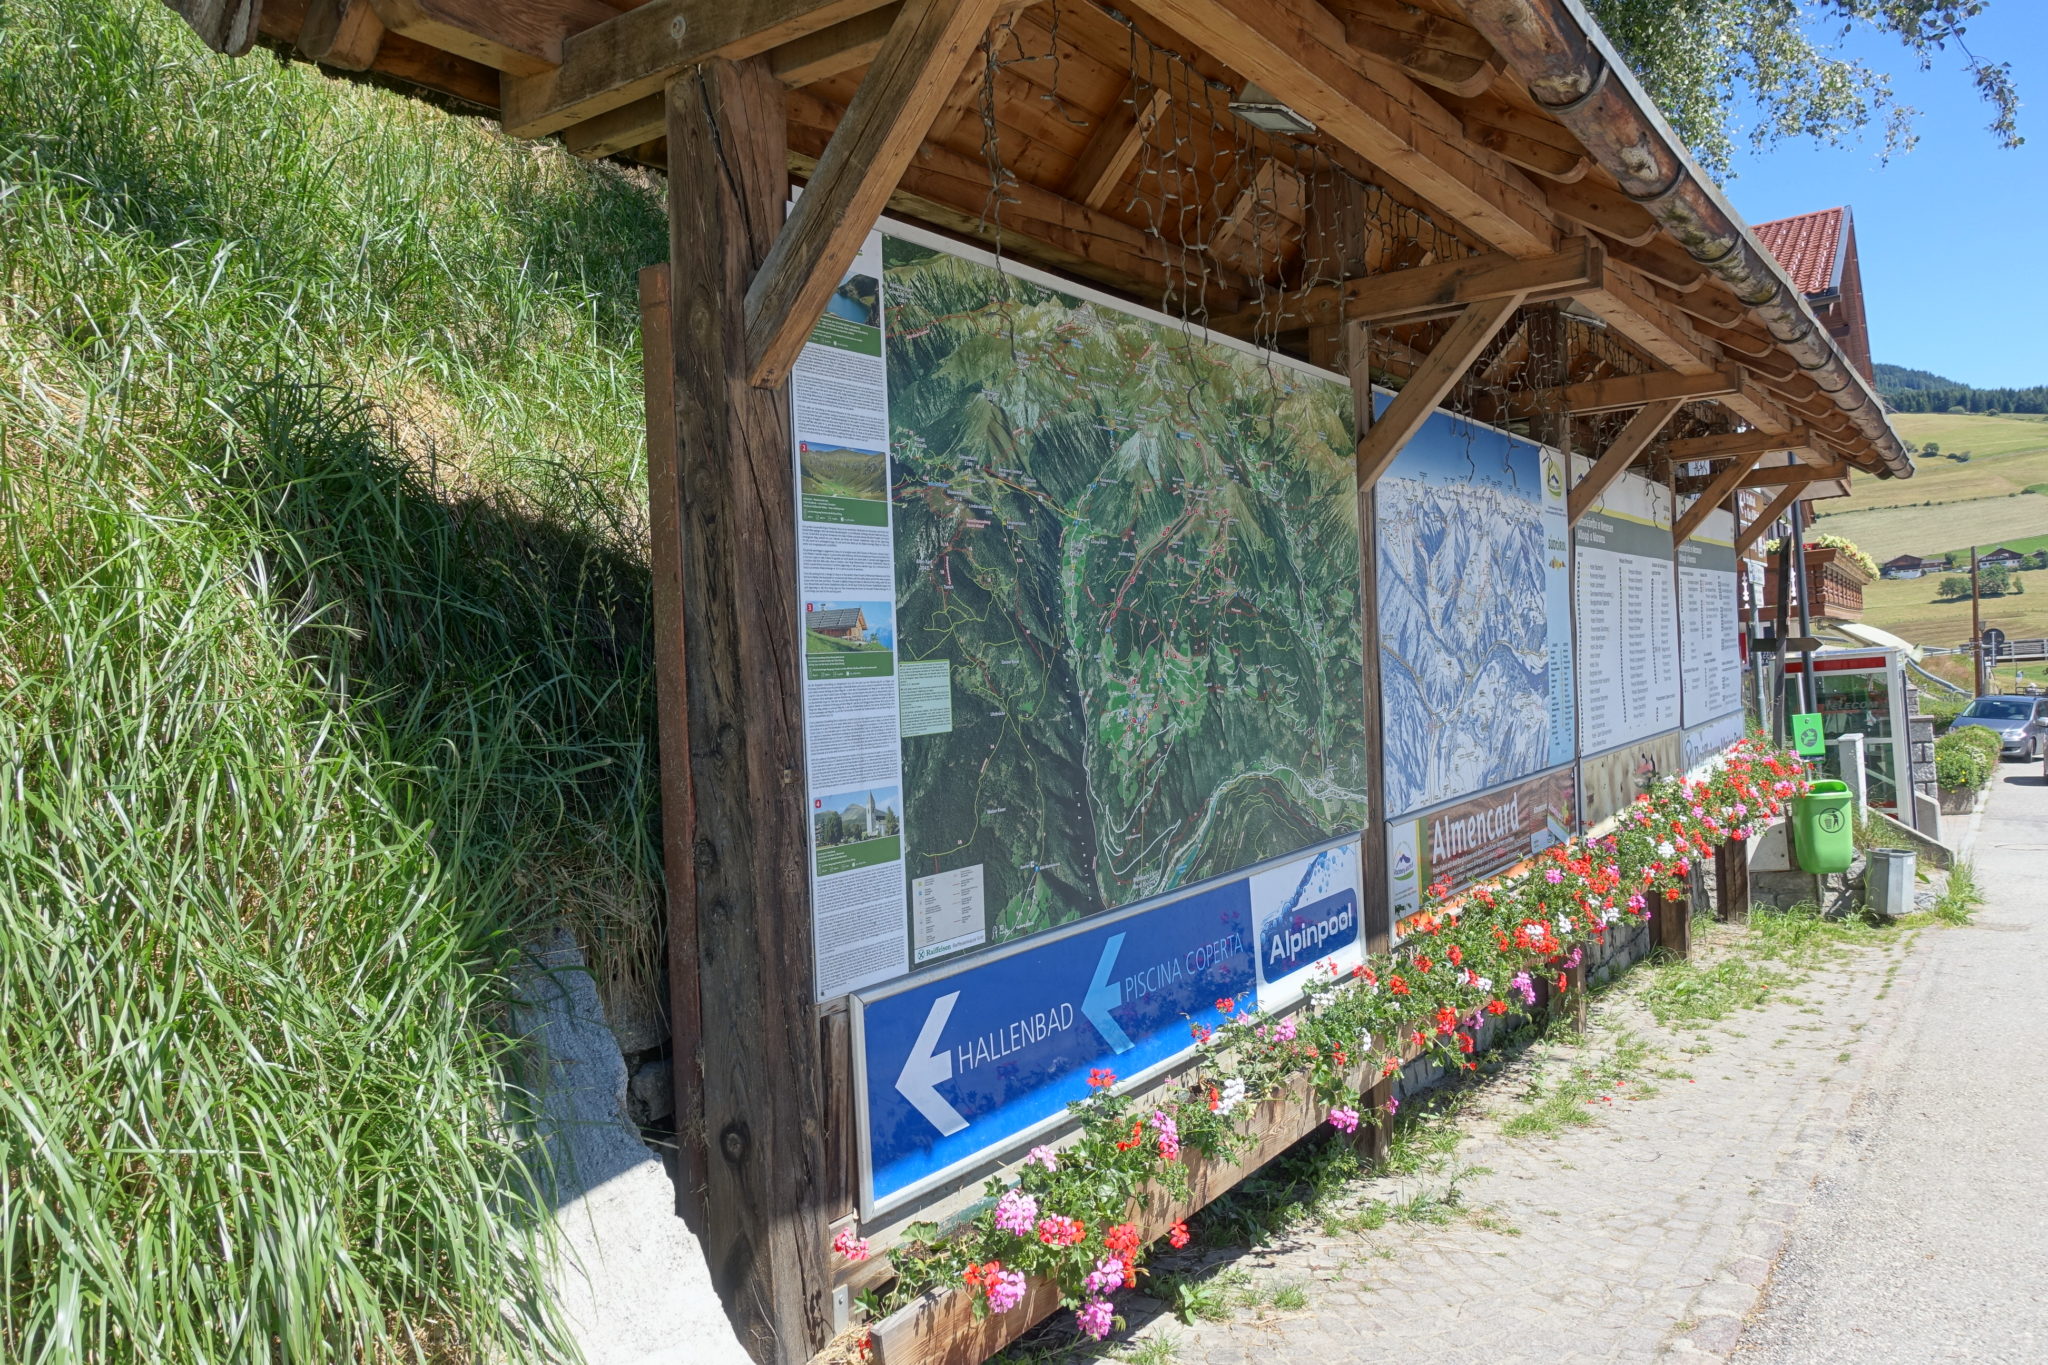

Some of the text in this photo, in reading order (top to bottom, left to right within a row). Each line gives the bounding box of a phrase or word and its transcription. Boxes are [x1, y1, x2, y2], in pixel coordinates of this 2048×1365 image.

[1432, 791, 1520, 864] Almencard
[1125, 932, 1244, 1002] PISCINA COPERTA
[1269, 902, 1353, 965] Alpinpool
[959, 1002, 1073, 1074] HALLENBAD
